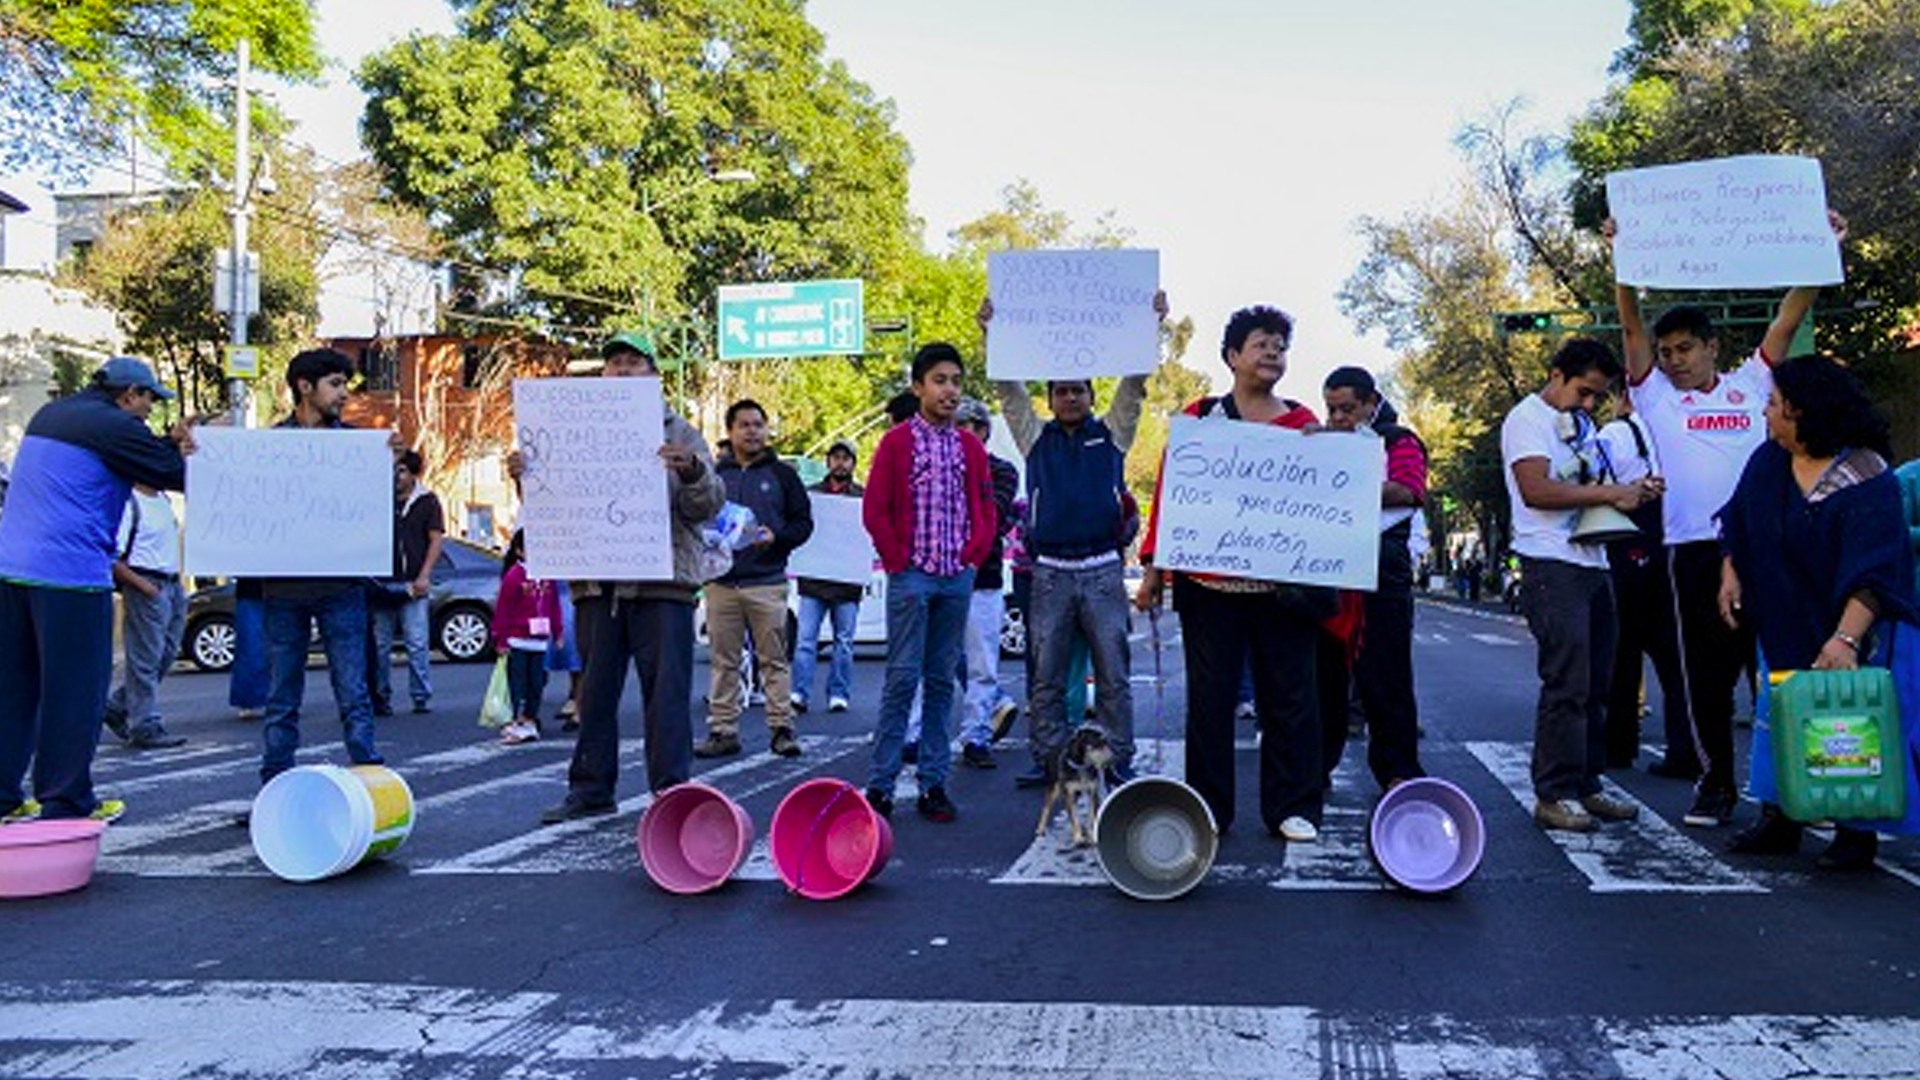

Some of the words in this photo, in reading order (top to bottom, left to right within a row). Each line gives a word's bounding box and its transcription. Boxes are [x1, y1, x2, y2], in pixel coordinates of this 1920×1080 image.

[1172, 441, 1318, 486] Solución
[1332, 470, 1350, 489] o
[1172, 484, 1214, 505] nos
[607, 498, 629, 528] 6
